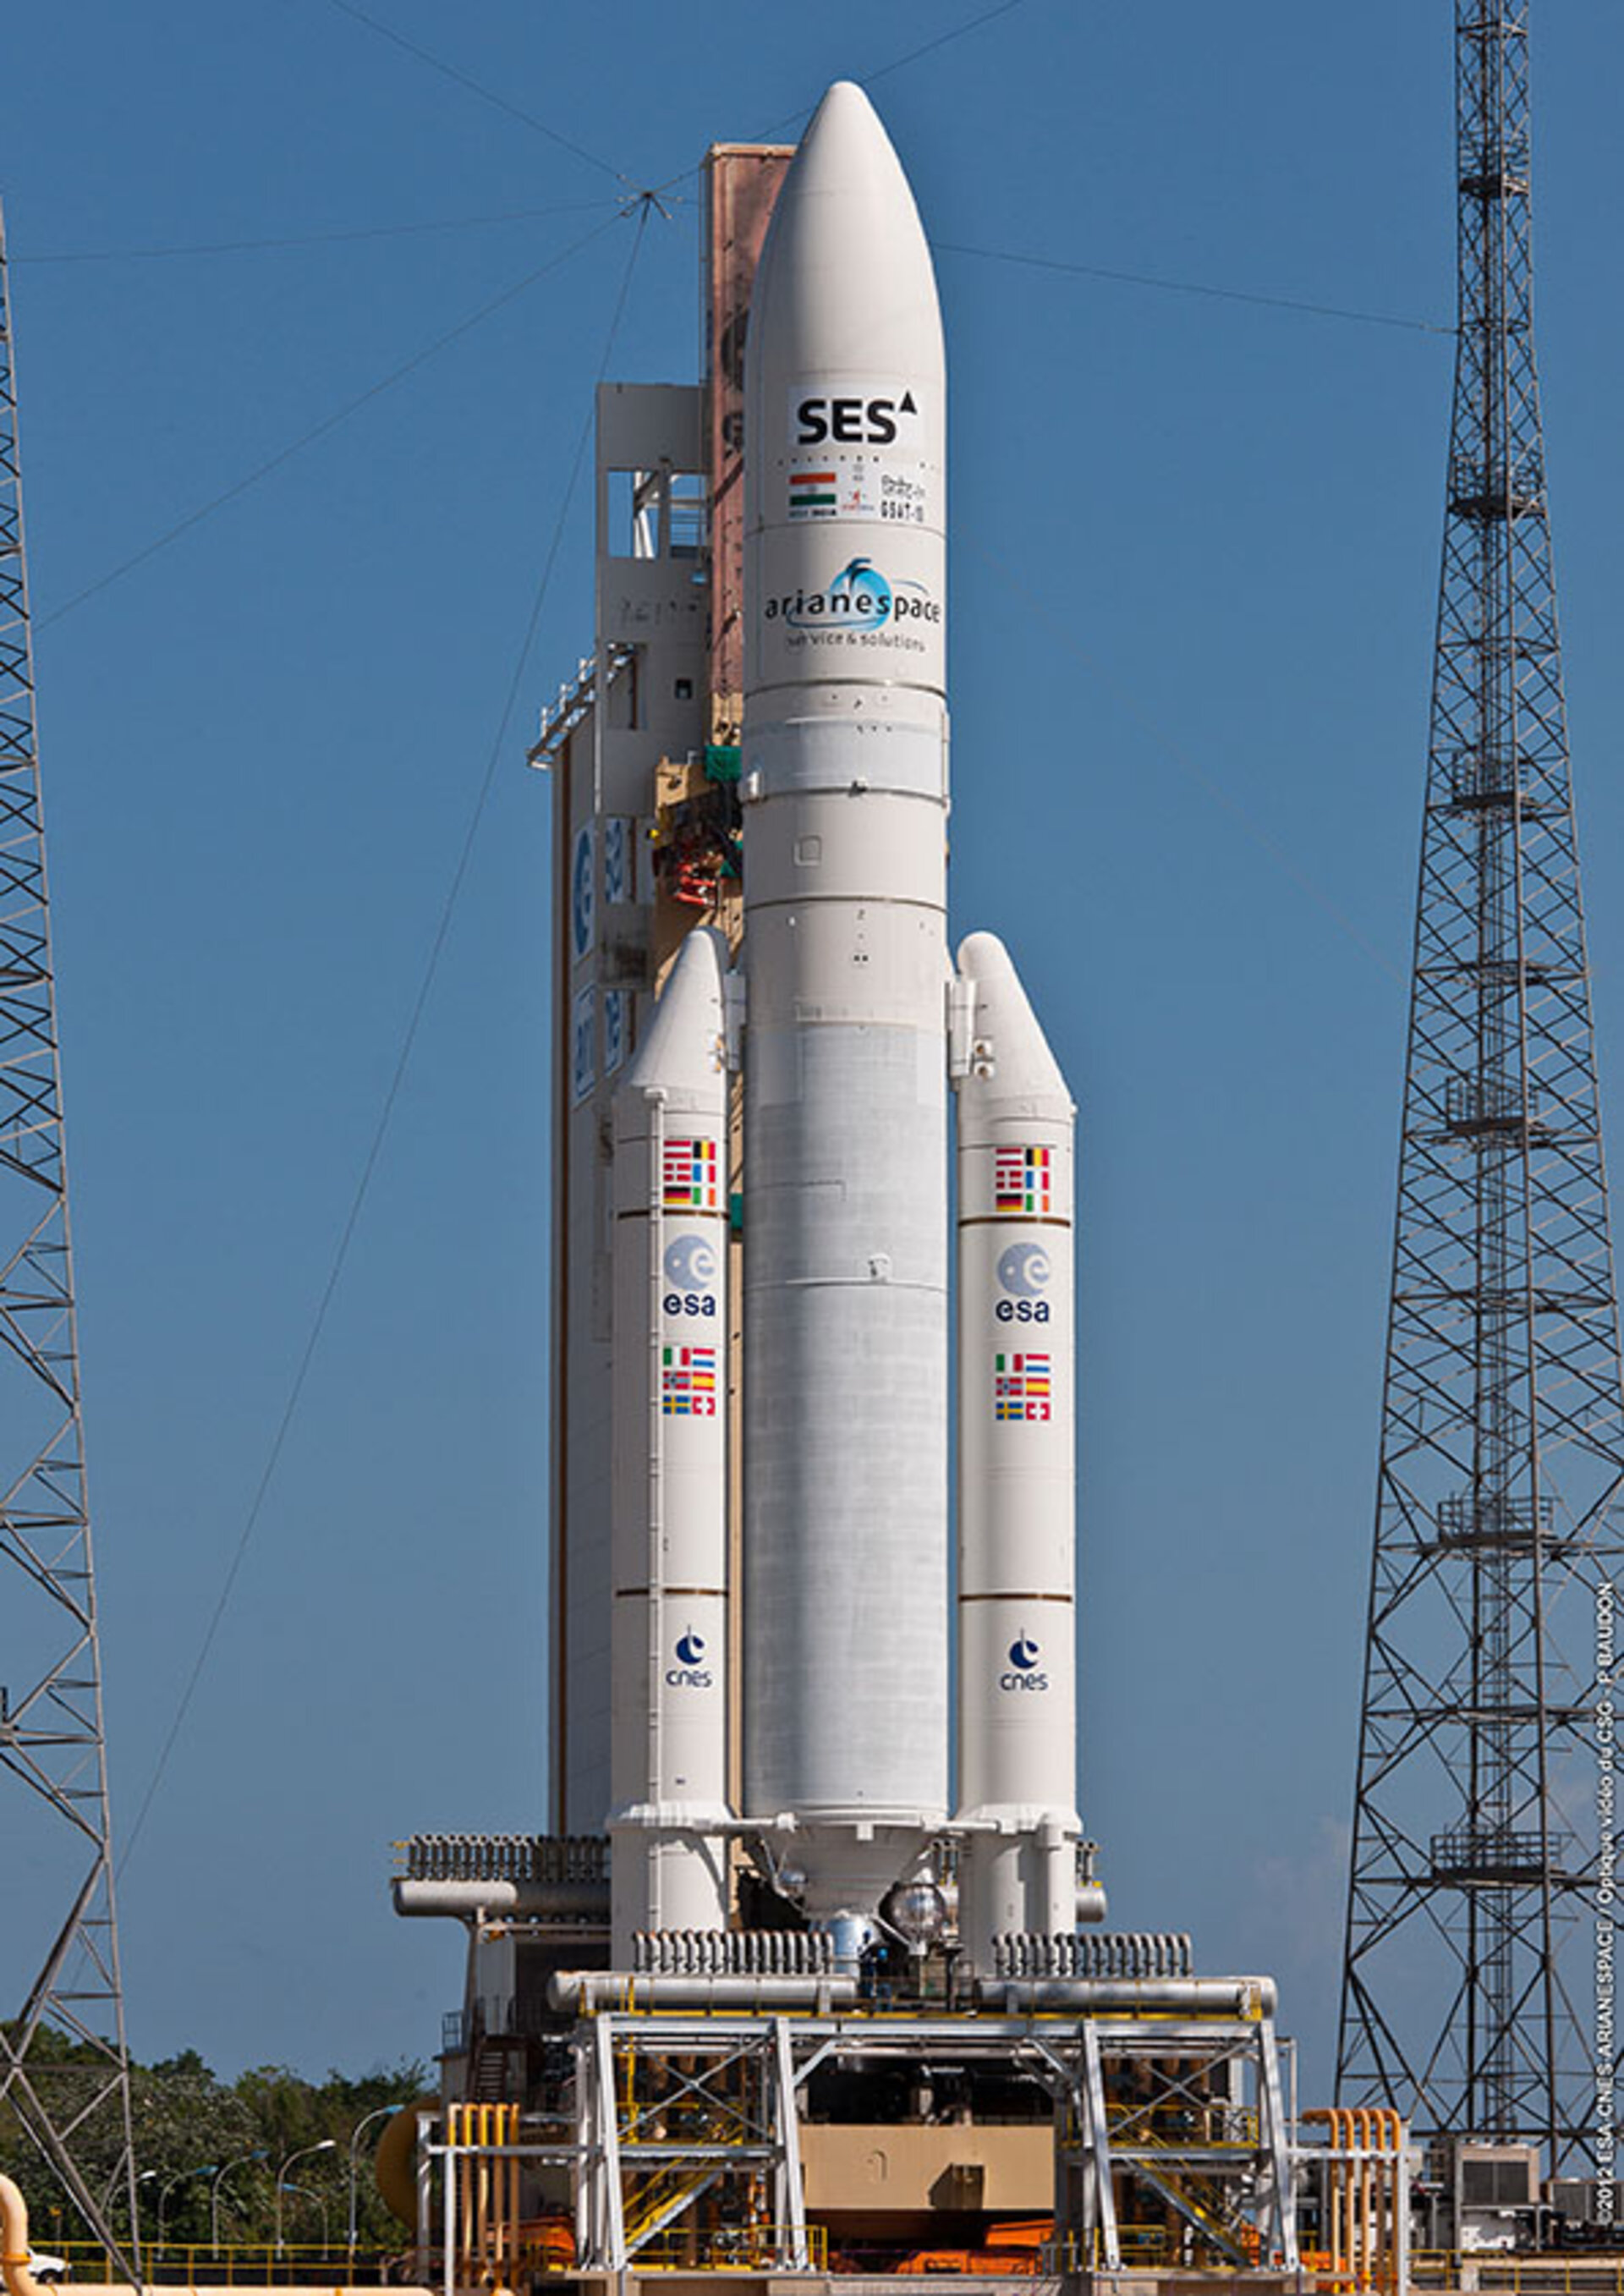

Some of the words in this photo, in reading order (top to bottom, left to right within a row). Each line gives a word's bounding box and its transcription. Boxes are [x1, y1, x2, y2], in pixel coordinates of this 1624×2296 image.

[798, 398, 897, 445] SES
[765, 590, 941, 623] arianespace
[847, 634, 857, 645] &
[860, 633, 926, 652] solutions
[662, 1294, 716, 1316] esa
[996, 1299, 1050, 1322] esa
[665, 1670, 712, 1688] cnes
[1000, 1673, 1049, 1691] cnes
